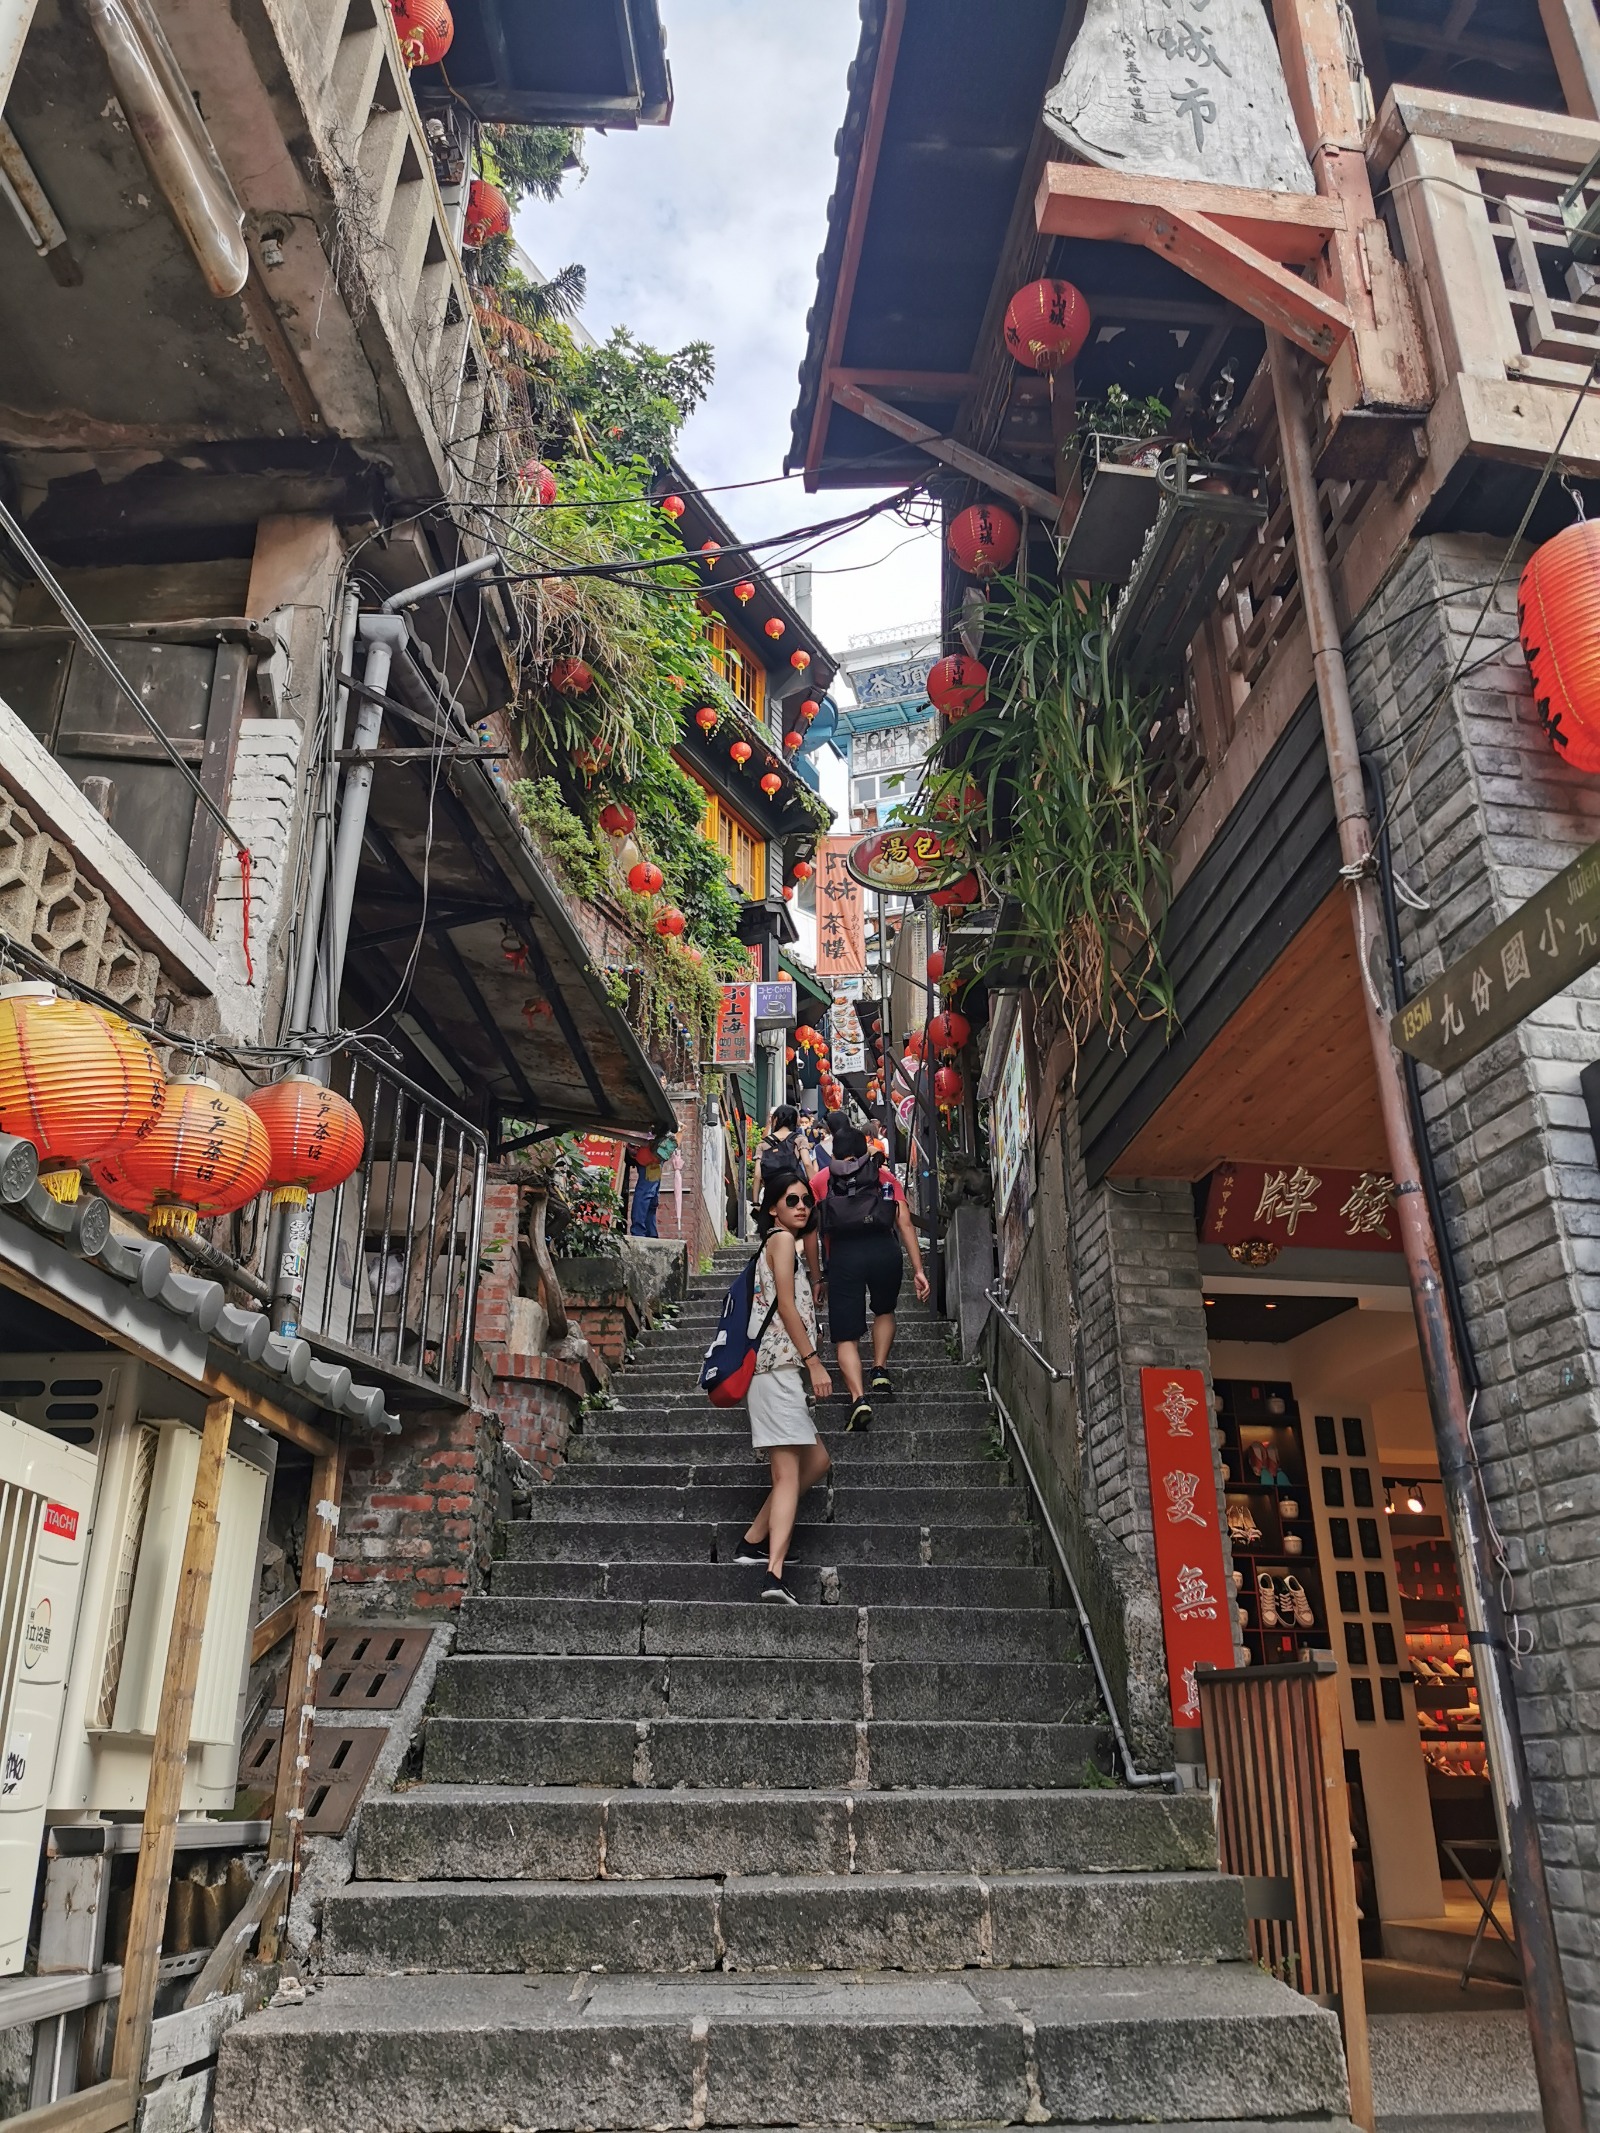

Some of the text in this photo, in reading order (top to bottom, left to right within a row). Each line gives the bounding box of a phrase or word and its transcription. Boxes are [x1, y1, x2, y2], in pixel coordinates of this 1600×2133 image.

[1158, 0, 1232, 152] 城市
[881, 837, 941, 862] 湯包
[822, 852, 857, 960] 阿妹茶樓
[722, 988, 746, 1035] 小上海
[1402, 908, 1566, 1046] 135M 九份國小
[44, 1508, 77, 1533] ITACHI
